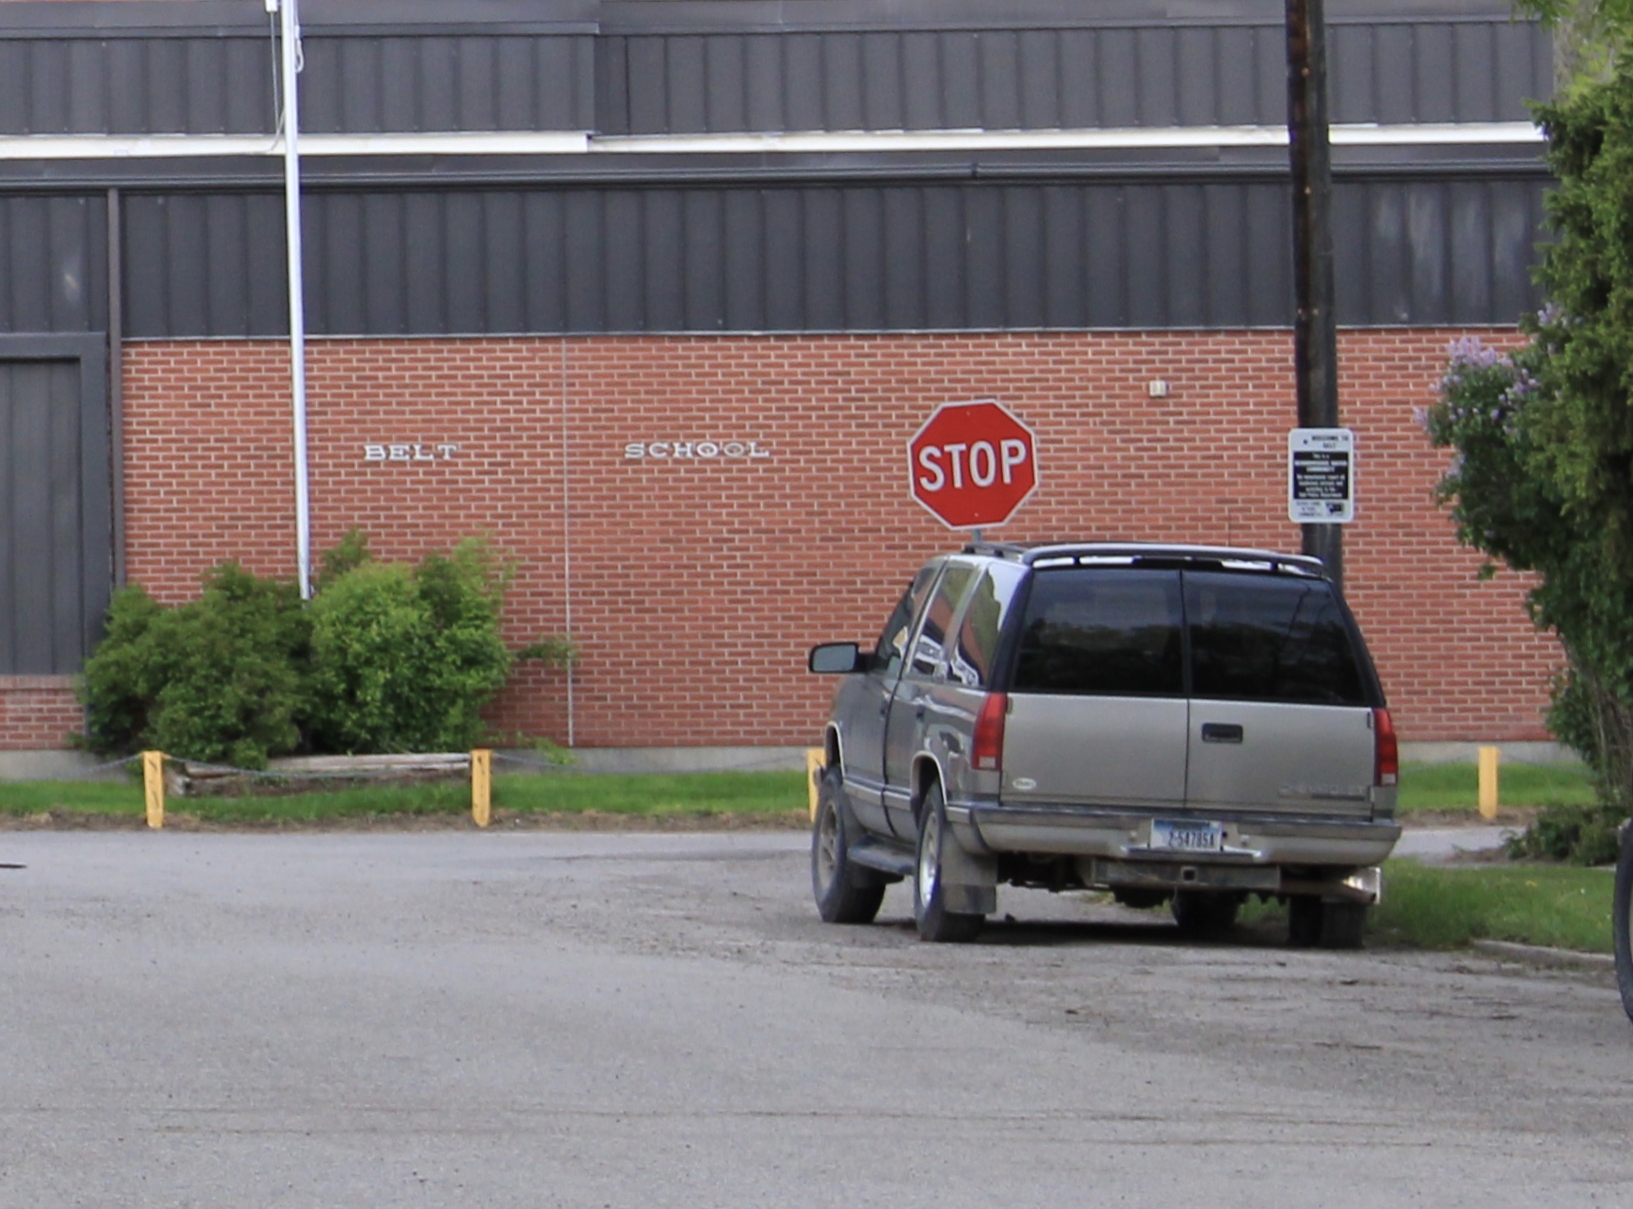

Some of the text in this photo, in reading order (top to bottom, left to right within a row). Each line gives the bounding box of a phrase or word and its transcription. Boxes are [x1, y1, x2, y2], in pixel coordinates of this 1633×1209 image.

[363, 441, 770, 461] BELT SCHOOL
[918, 438, 1027, 492] STOP
